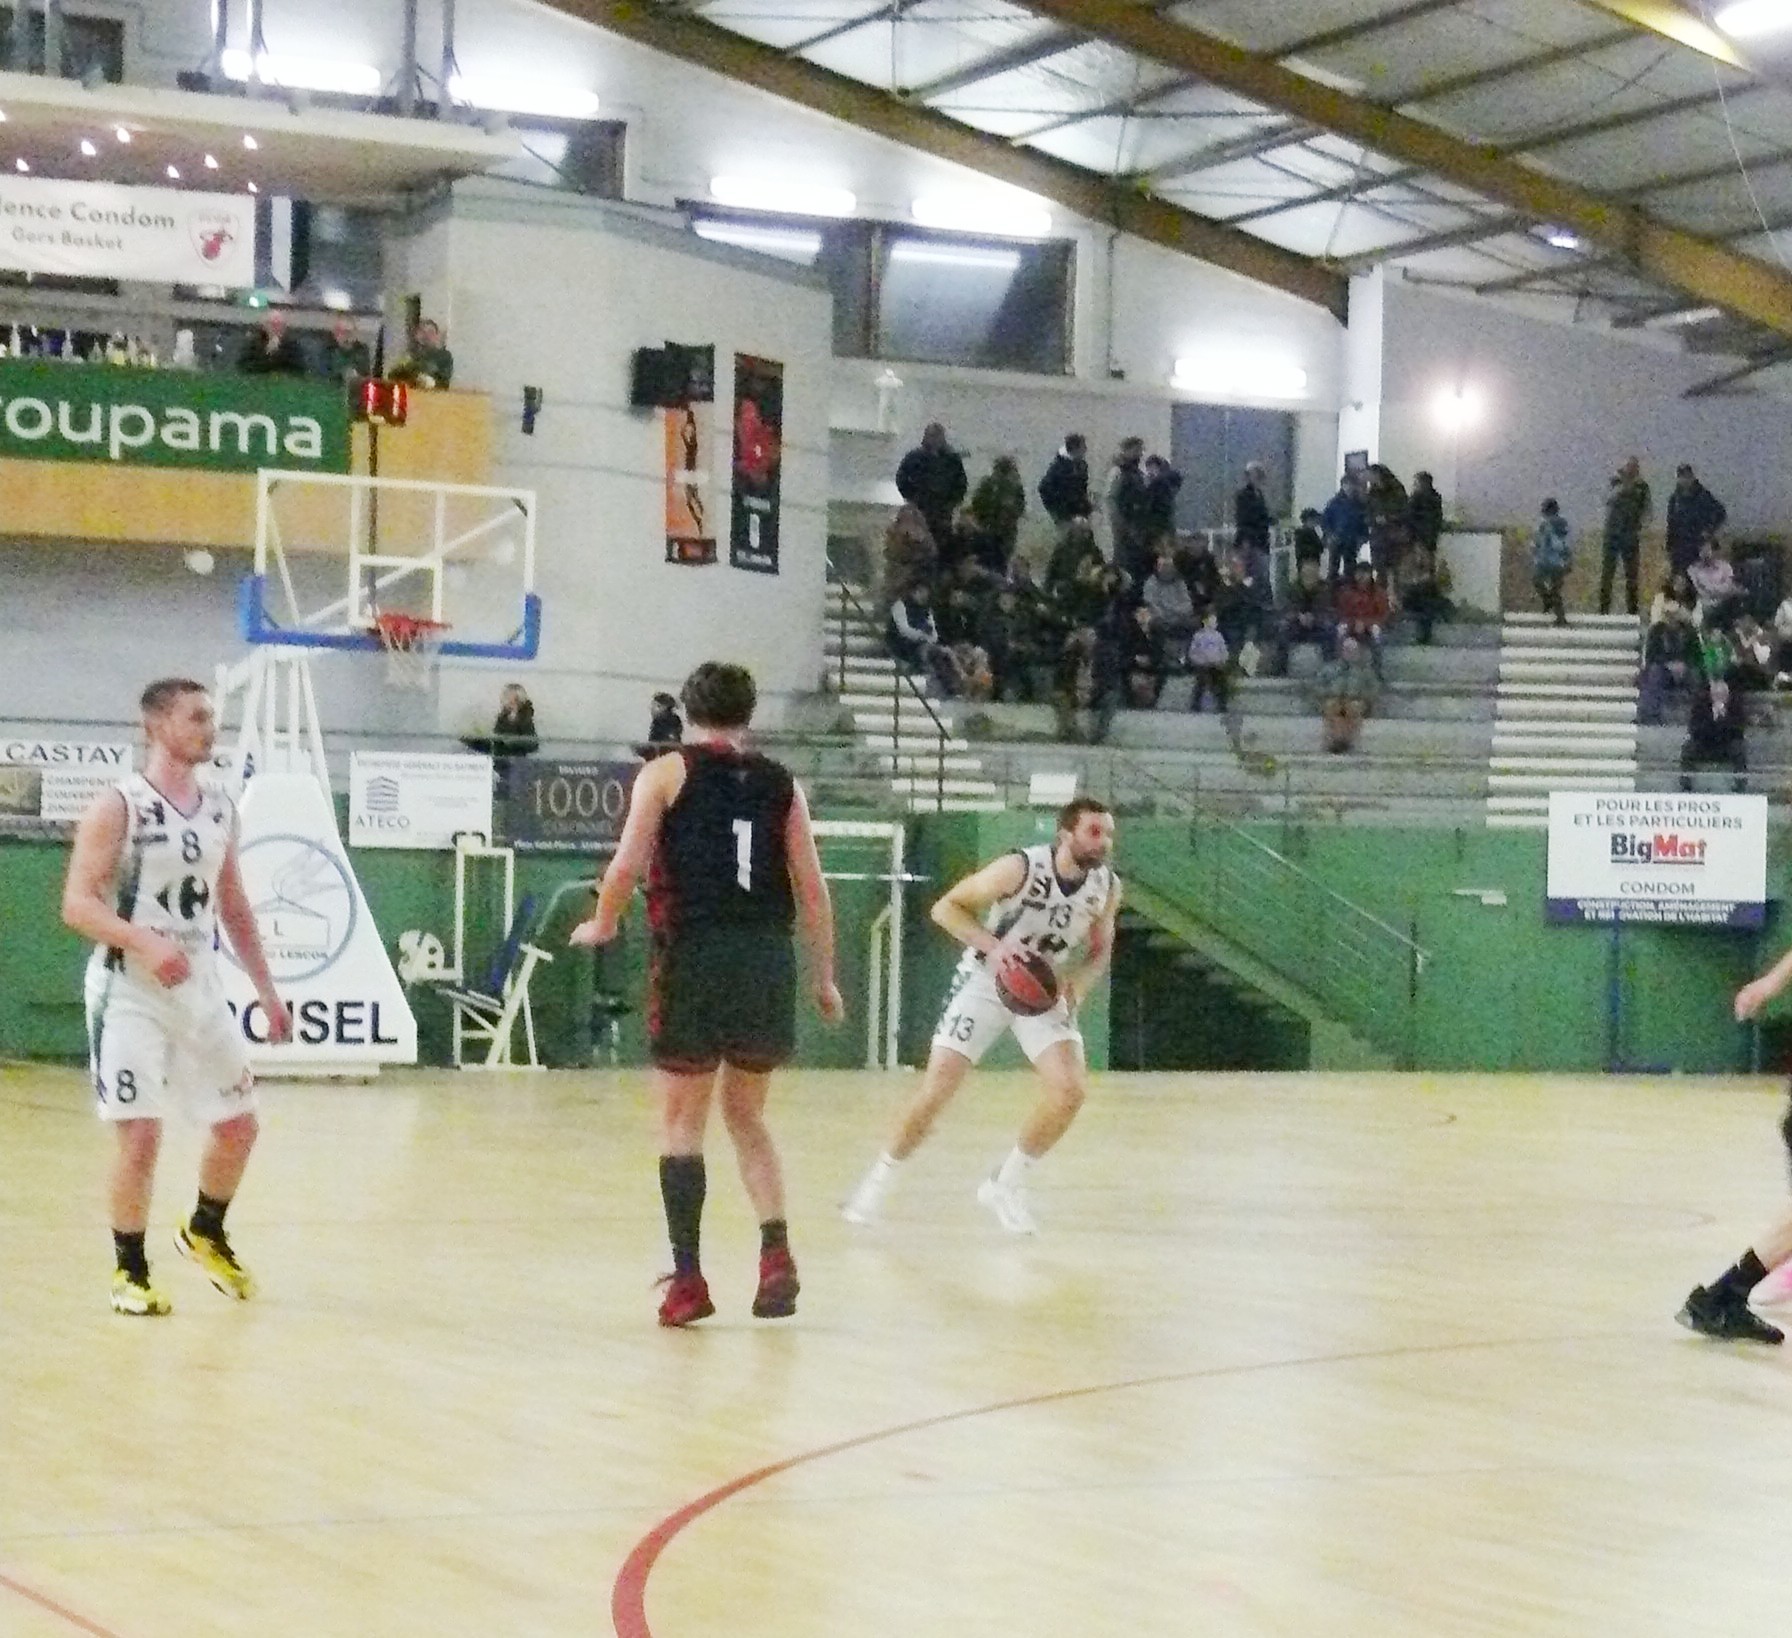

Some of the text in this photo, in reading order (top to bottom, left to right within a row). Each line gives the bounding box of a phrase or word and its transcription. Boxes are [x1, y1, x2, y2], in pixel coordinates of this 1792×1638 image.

[70, 201, 175, 229] Condom
[61, 229, 123, 251] Basket
[0, 394, 322, 460] oupama
[6, 741, 127, 765] CASTAY
[47, 775, 119, 788] CHARPENT
[47, 789, 95, 801] COUVER
[48, 802, 83, 814] ZINGU
[535, 778, 625, 818] 1000
[1596, 799, 1721, 813] POUR LES PROS
[355, 814, 410, 829] ATECO
[1574, 814, 1742, 829] ET LES PARTICULIERS
[181, 829, 201, 864] 8
[731, 818, 753, 892] 1
[1611, 833, 1707, 860] BigMat
[1620, 881, 1695, 895] CONDOM
[1048, 903, 1072, 930] 13
[227, 1000, 399, 1044] OISEL
[949, 1014, 975, 1042] 13
[116, 1069, 137, 1103] 8
